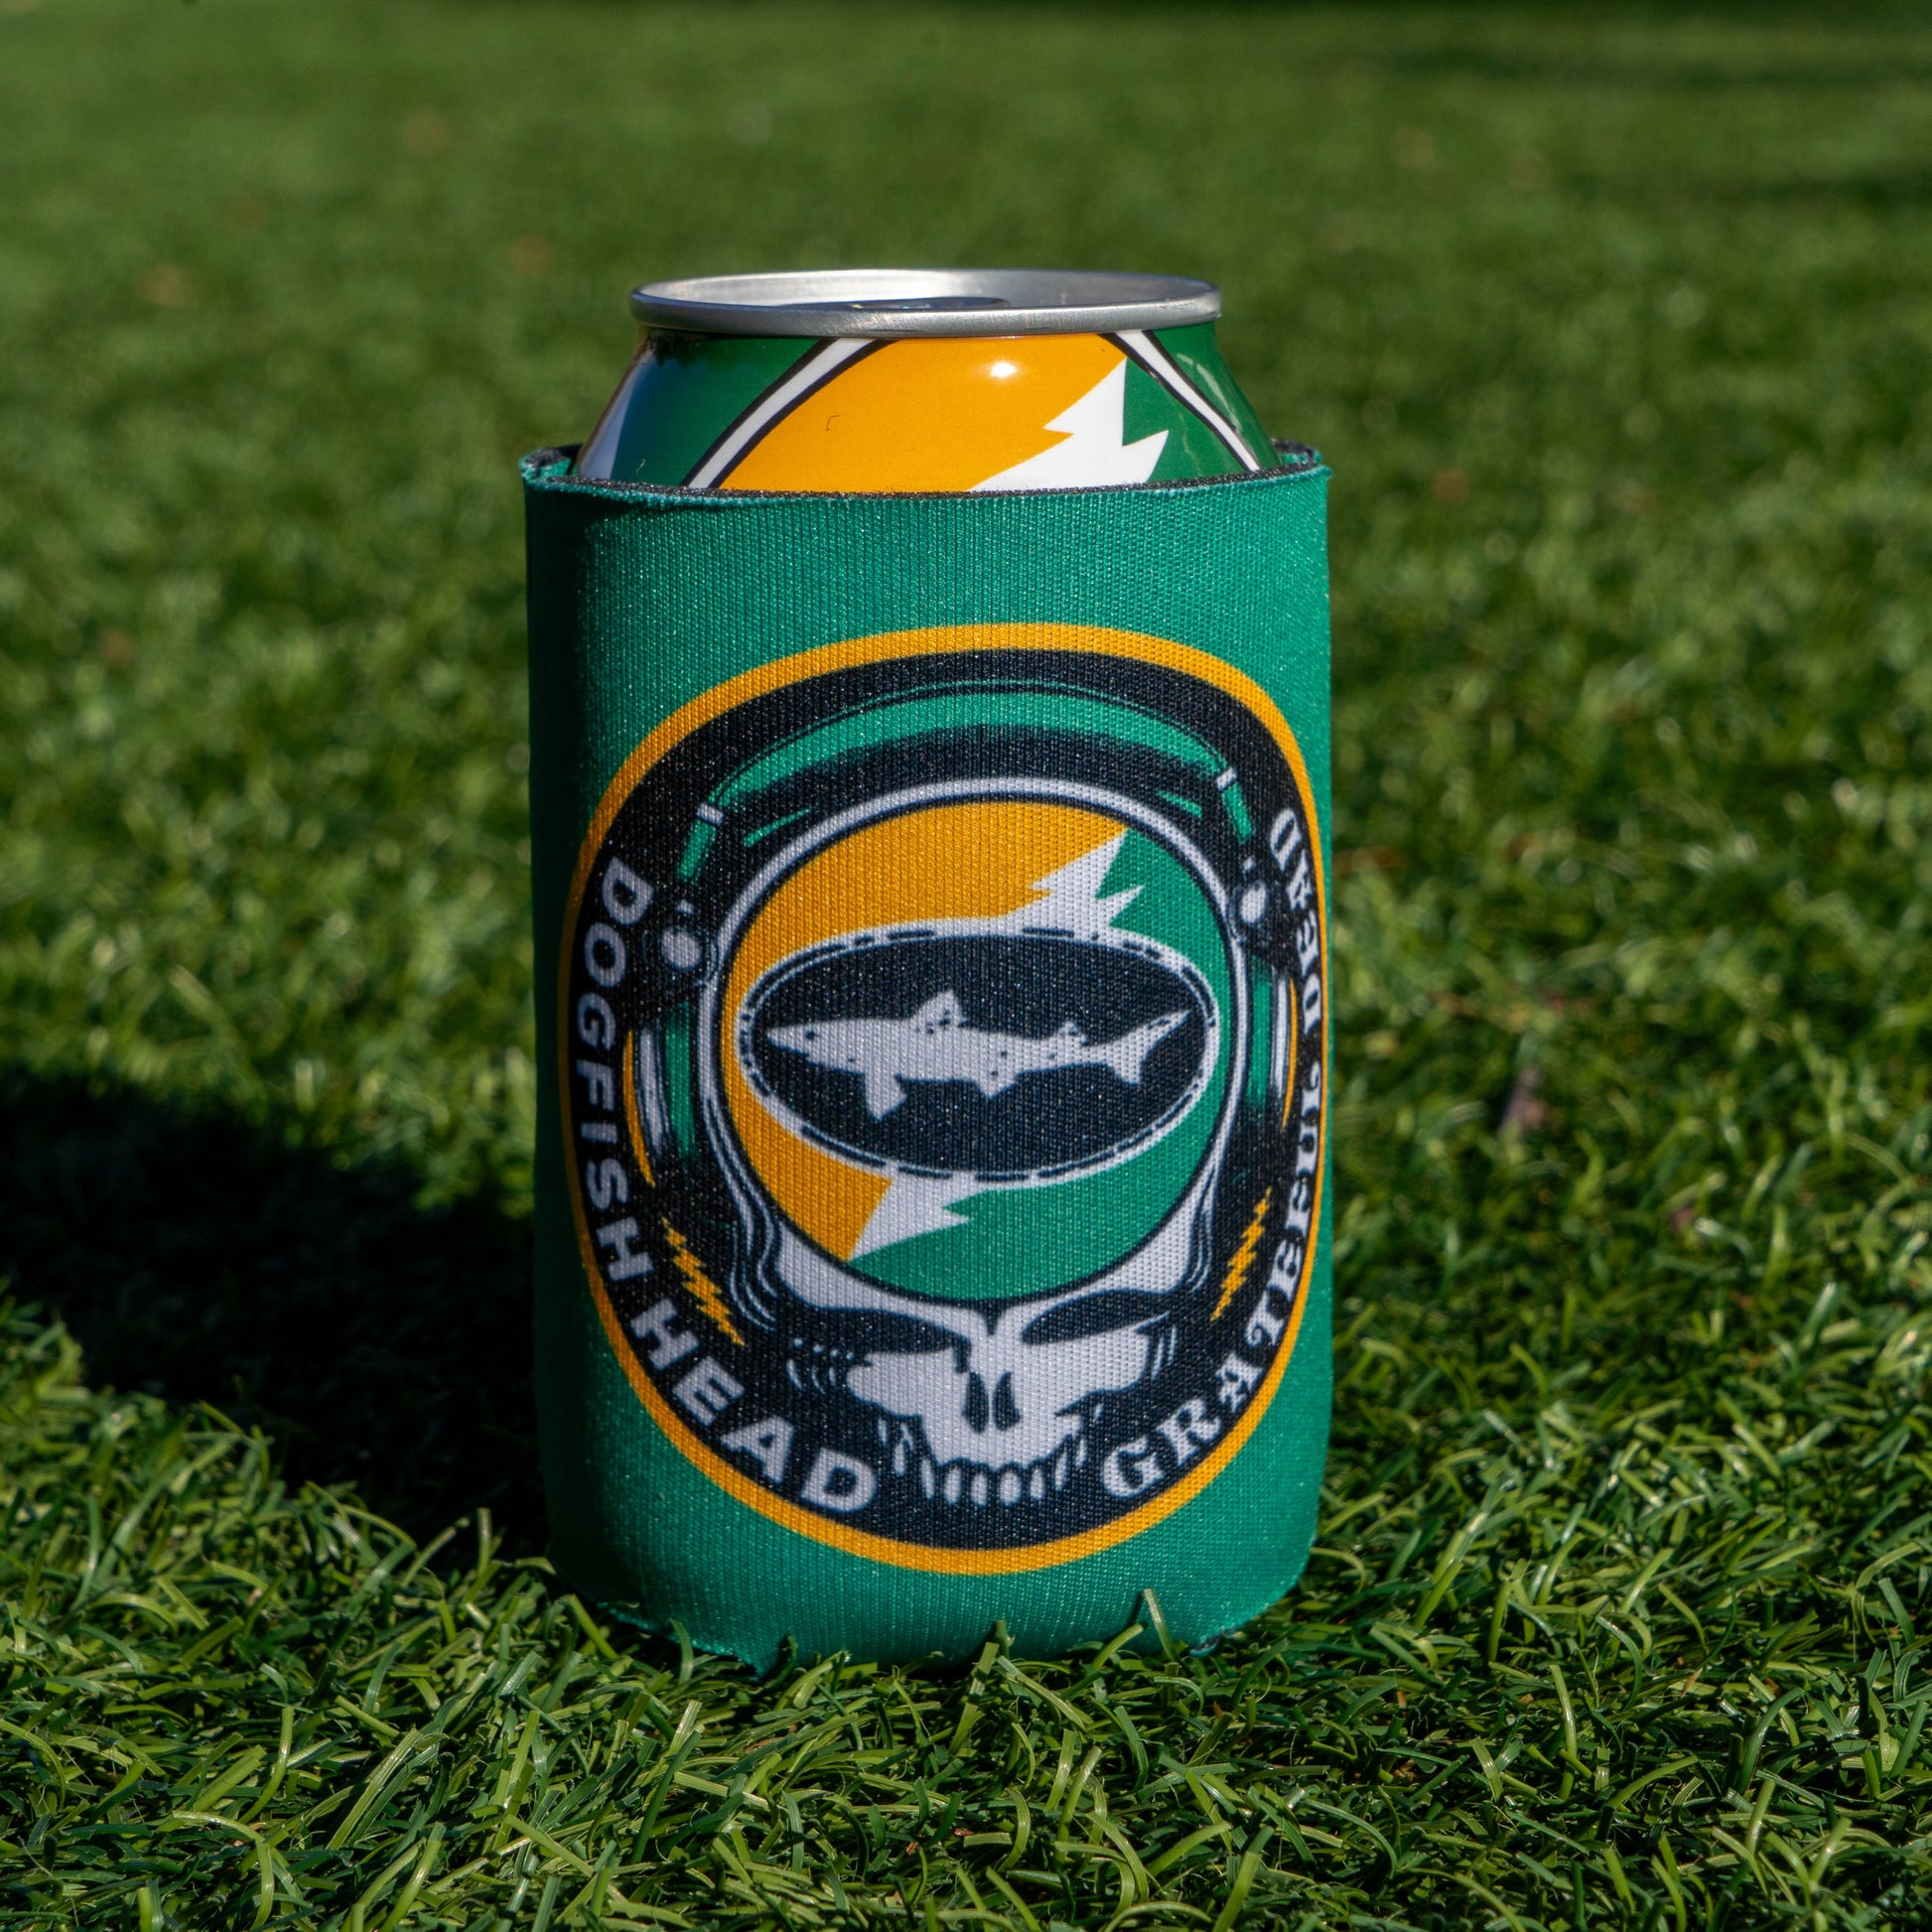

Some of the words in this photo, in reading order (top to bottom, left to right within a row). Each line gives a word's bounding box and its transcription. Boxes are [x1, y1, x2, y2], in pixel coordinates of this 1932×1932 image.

[576, 855, 654, 1282] DOGFISH
[631, 1299, 878, 1514] HEAD
[1102, 1060, 1321, 1499] GRATEFUL
[1269, 807, 1321, 1035] DEAD
